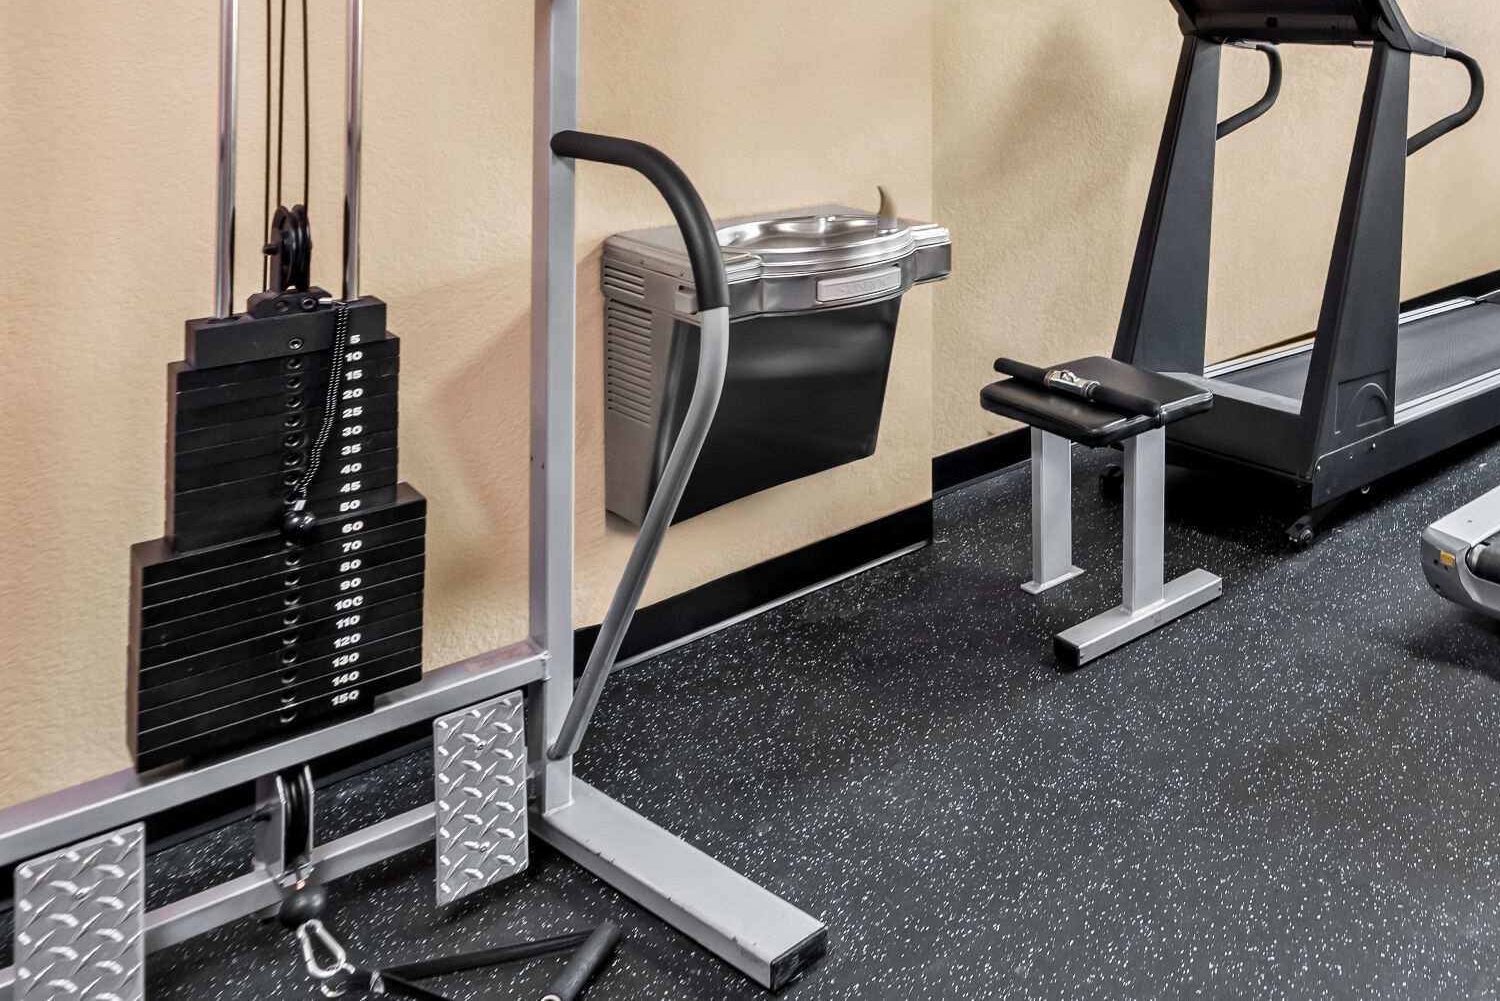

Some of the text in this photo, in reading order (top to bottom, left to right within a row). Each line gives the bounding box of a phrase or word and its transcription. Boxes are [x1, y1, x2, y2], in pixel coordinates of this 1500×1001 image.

[350, 334, 361, 344] 5
[345, 351, 363, 362] 10
[345, 369, 363, 381] 15
[342, 388, 364, 400] 20
[342, 406, 363, 419] 25
[342, 425, 363, 437] 30
[341, 443, 362, 456] 35
[340, 462, 362, 475] 40
[340, 481, 361, 493] 45
[339, 499, 361, 512] 50
[342, 520, 364, 534] 60
[342, 539, 362, 553] 70
[340, 559, 362, 572] 80
[340, 577, 362, 591] 90
[335, 614, 361, 629] 110
[333, 632, 361, 648] 120
[332, 652, 360, 668] 130
[331, 670, 360, 687] 140
[331, 689, 359, 706] 150
